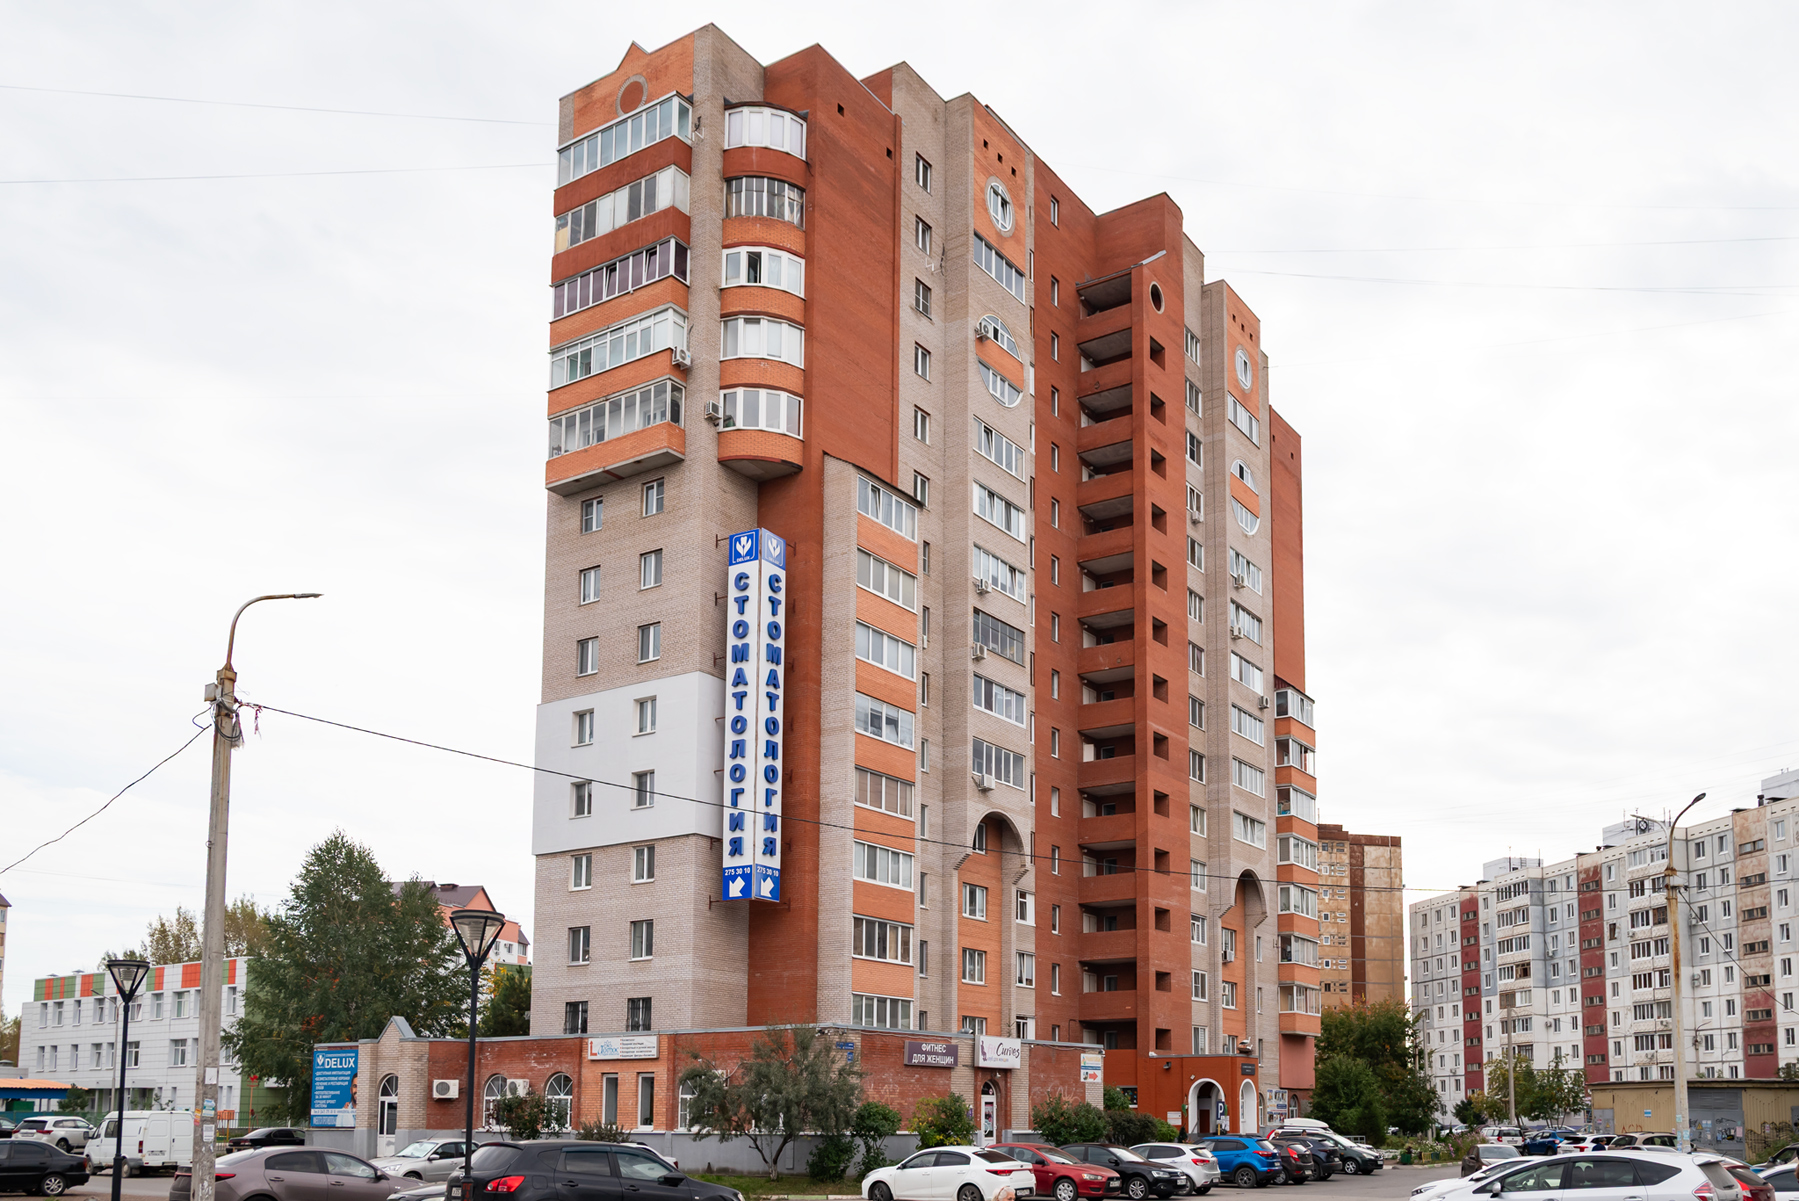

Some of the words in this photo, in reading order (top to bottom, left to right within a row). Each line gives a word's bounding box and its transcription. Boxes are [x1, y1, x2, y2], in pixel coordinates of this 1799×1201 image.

[728, 571, 750, 857] СТОМАТОЛОГИЯ
[762, 573, 782, 856] СТОМАТОЛОГИЯ
[757, 866, 765, 874] 275
[921, 1043, 947, 1053] ФИТНЕС
[325, 1057, 355, 1068] DELUX
[912, 1053, 926, 1064] ДЛЯ
[926, 1054, 955, 1066] ЖЕНЩИН
[1218, 1103, 1223, 1118] P
